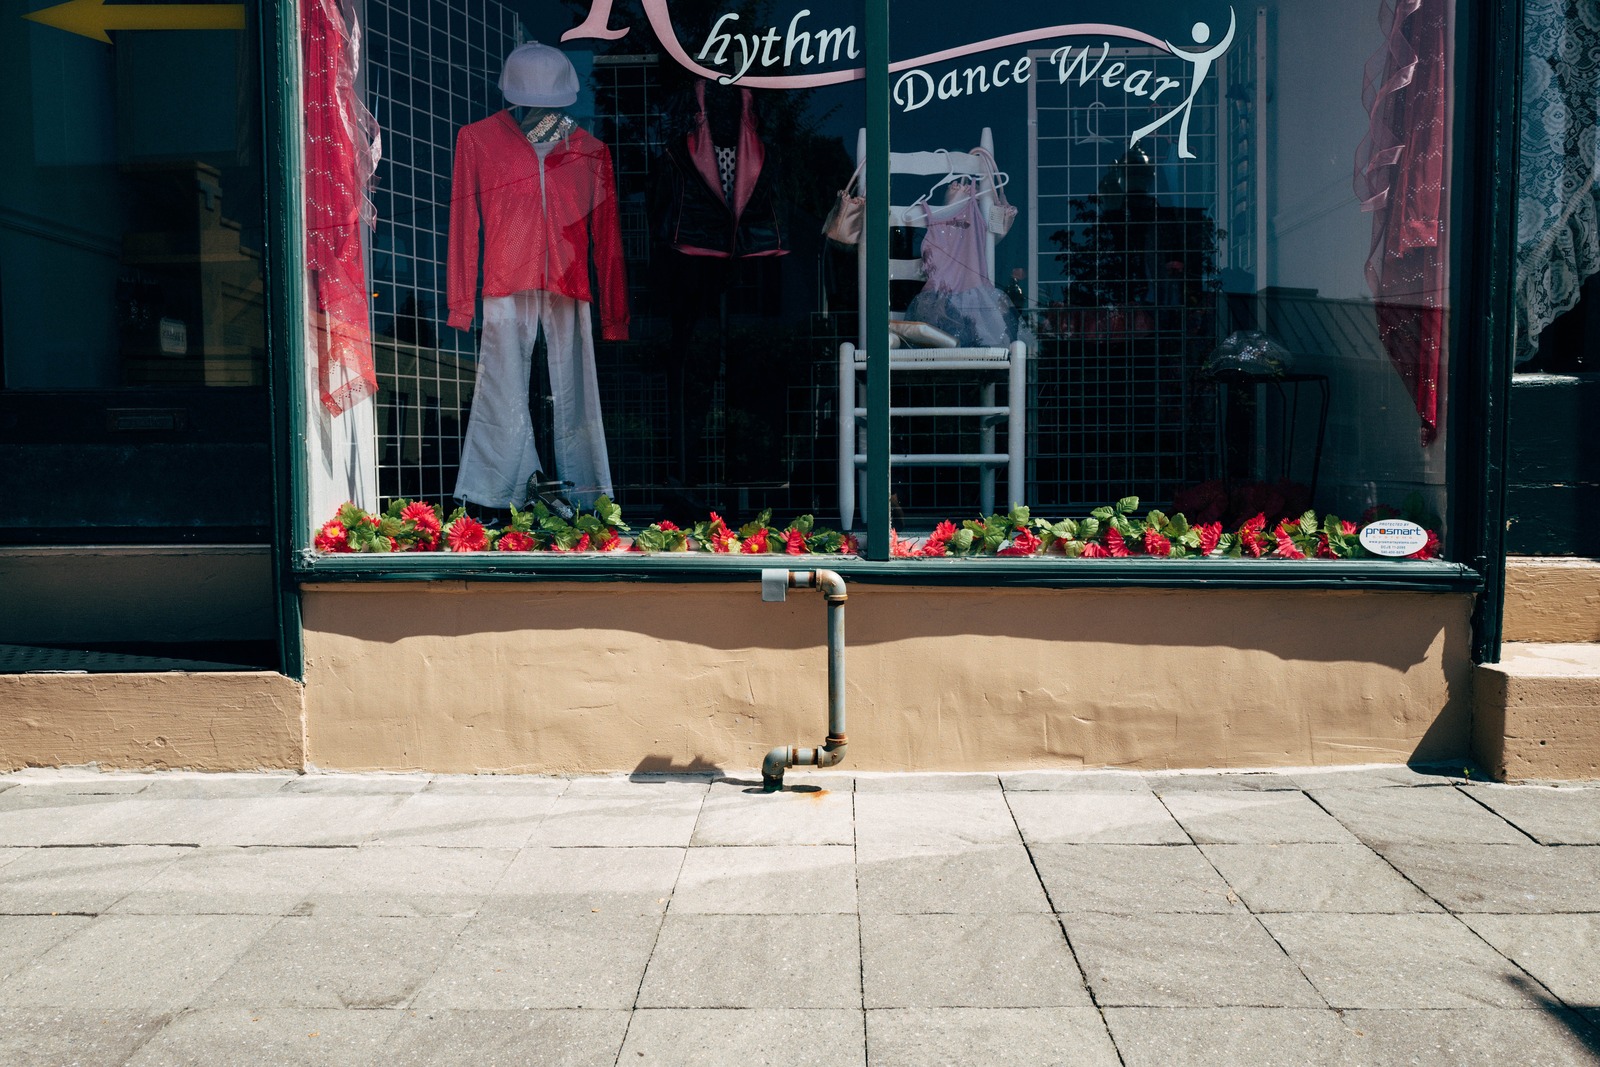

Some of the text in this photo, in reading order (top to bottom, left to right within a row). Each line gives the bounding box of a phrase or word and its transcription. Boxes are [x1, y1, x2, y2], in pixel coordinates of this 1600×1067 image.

[892, 41, 1180, 113] Dance Wear
[1366, 527, 1421, 537] prosmart
